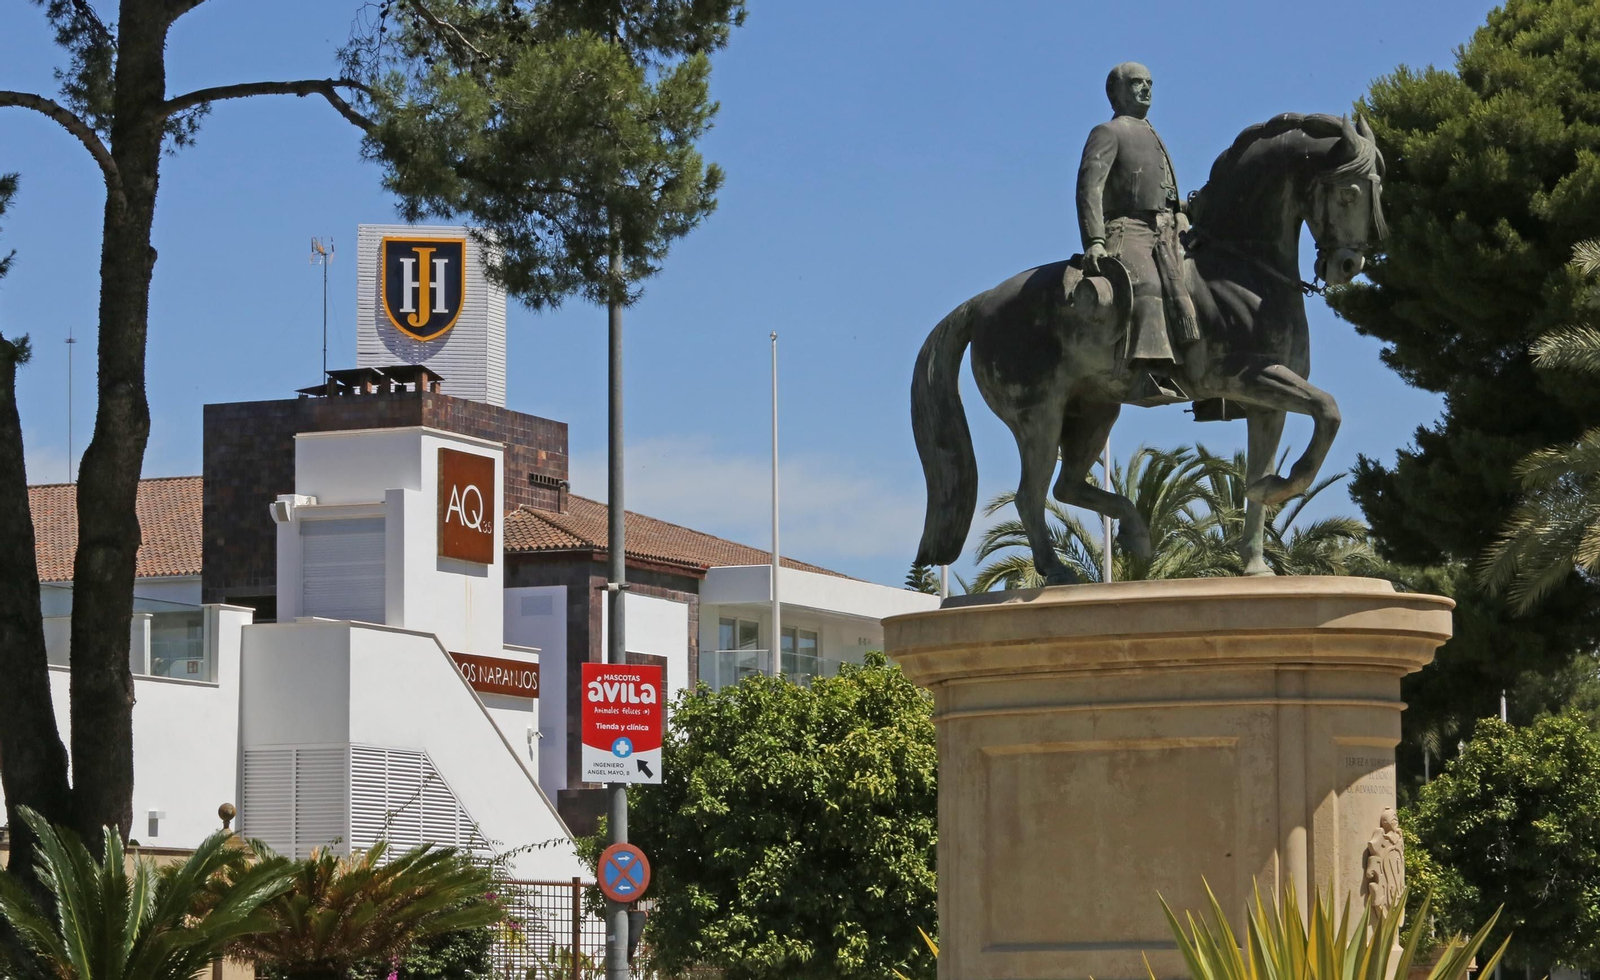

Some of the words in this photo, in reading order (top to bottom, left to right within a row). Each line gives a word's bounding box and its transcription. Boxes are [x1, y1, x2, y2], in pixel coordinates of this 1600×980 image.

[456, 662, 476, 682] OS
[479, 665, 538, 690] NARANJOS
[603, 674, 641, 682] MASCOTAS
[594, 706, 620, 715] Animales
[622, 706, 641, 716] felices
[595, 722, 620, 730] Tienda
[620, 724, 626, 732] y
[626, 723, 650, 731] clínica
